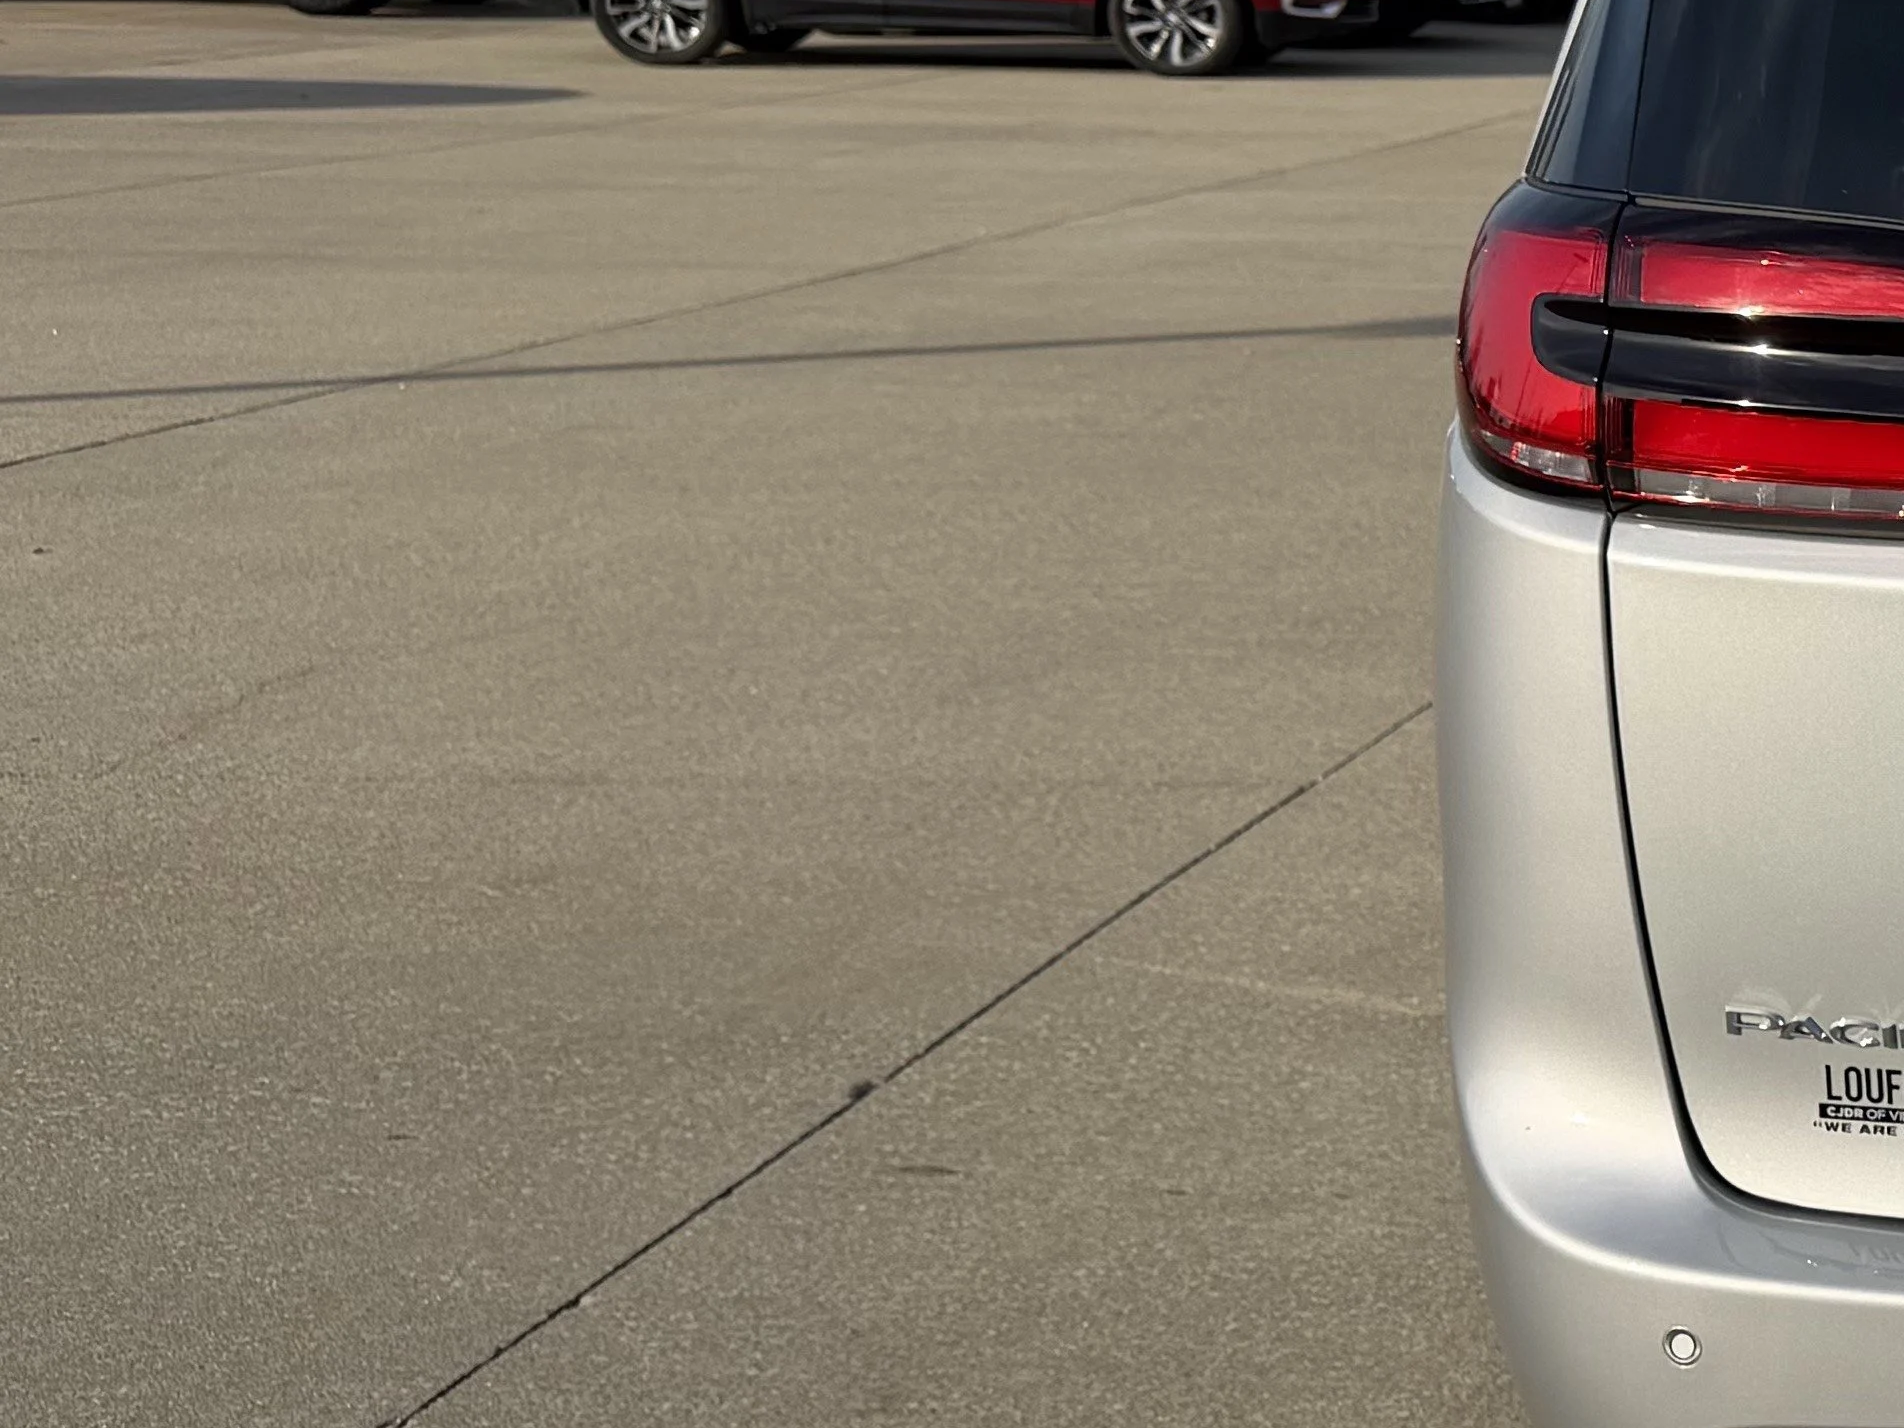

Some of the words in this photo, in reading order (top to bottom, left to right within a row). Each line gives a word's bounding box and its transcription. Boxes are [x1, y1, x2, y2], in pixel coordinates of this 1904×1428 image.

[1826, 1105, 1864, 1119] CJDR
[1866, 1108, 1887, 1121] OF
[1859, 1123, 1898, 1137] ARE
